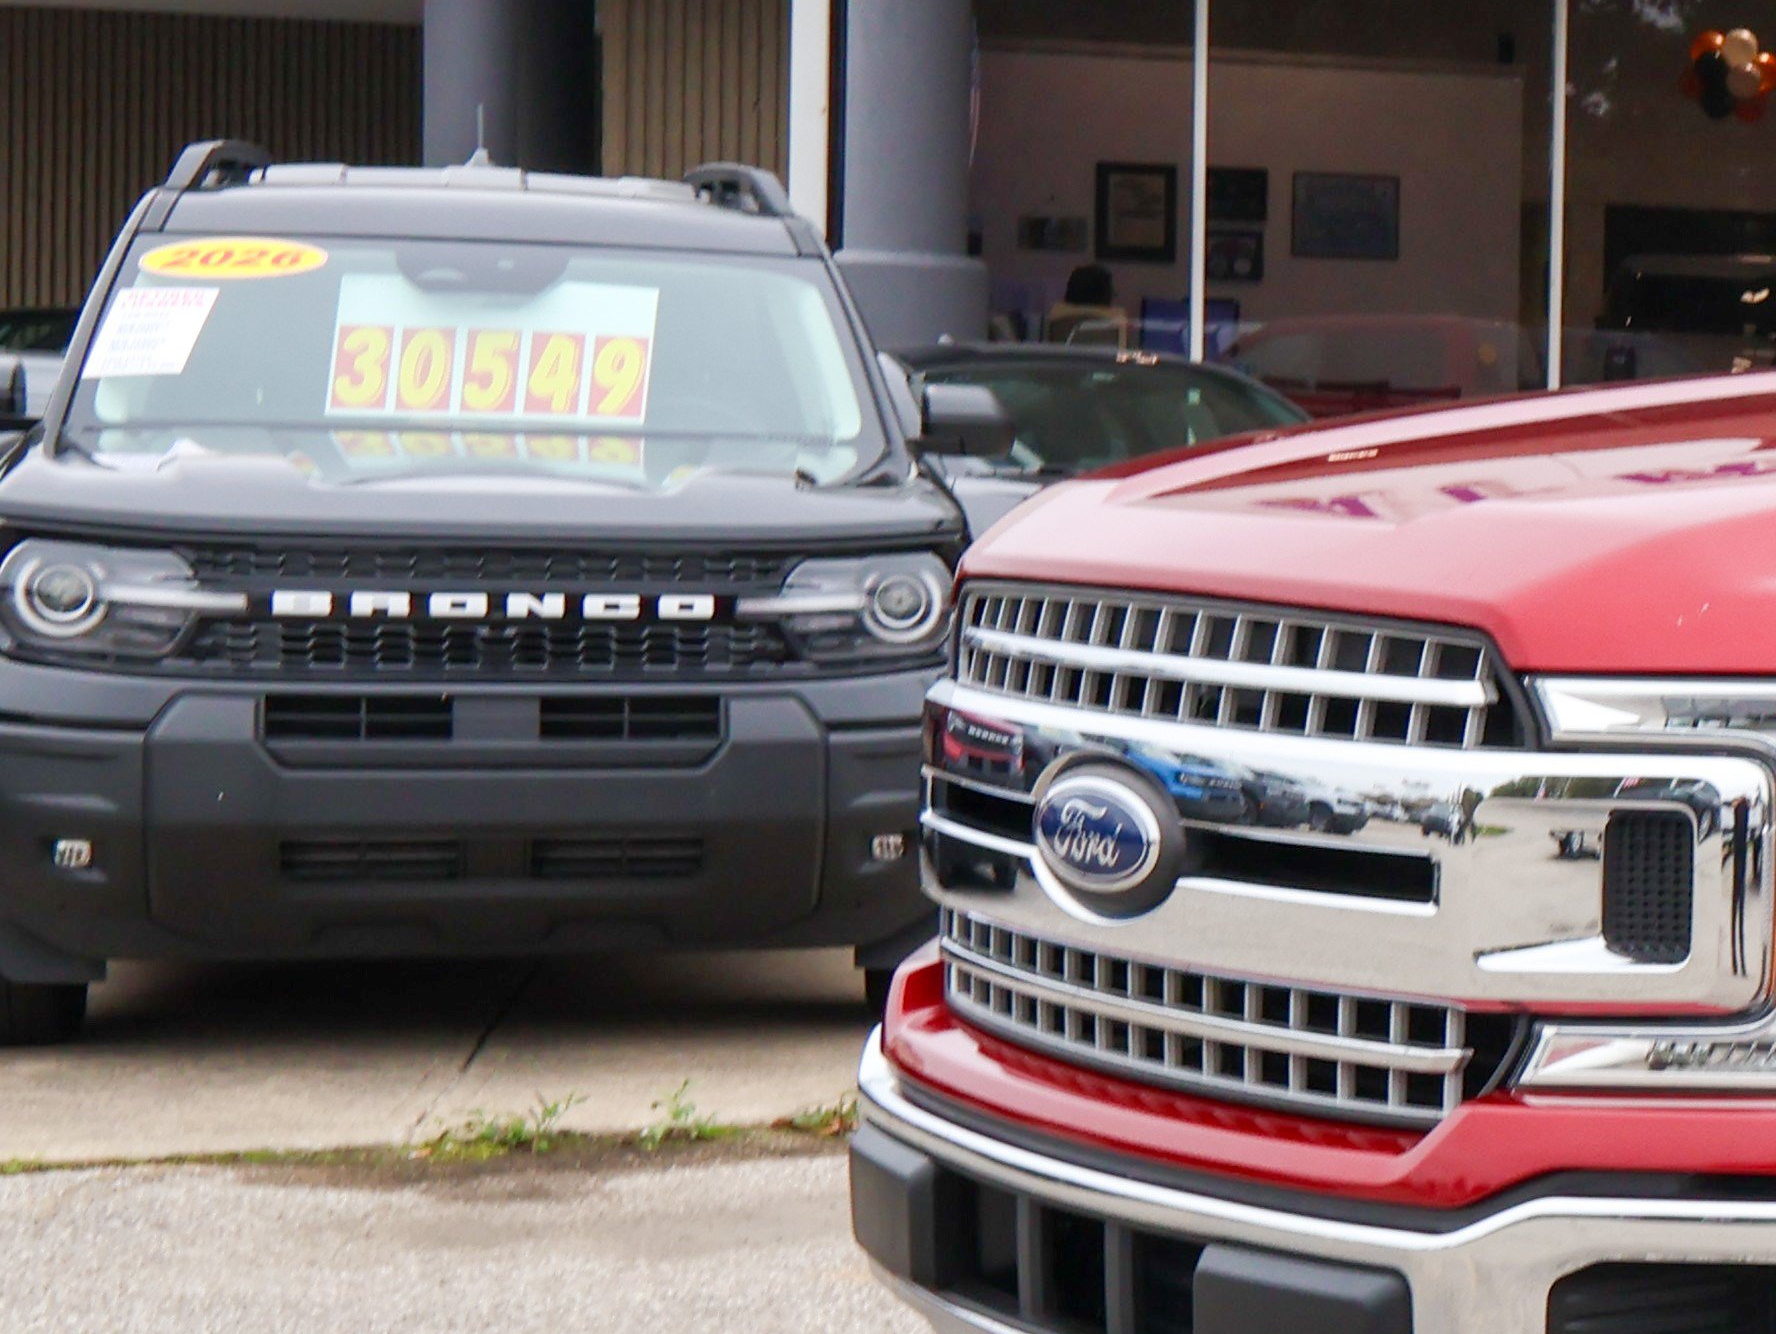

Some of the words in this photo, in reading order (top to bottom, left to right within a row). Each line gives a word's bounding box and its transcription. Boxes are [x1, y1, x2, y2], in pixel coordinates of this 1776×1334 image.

[160, 247, 304, 269] 2026
[333, 327, 644, 415] 30549
[270, 589, 716, 620] BRONCO
[1053, 797, 1122, 867] Ford
